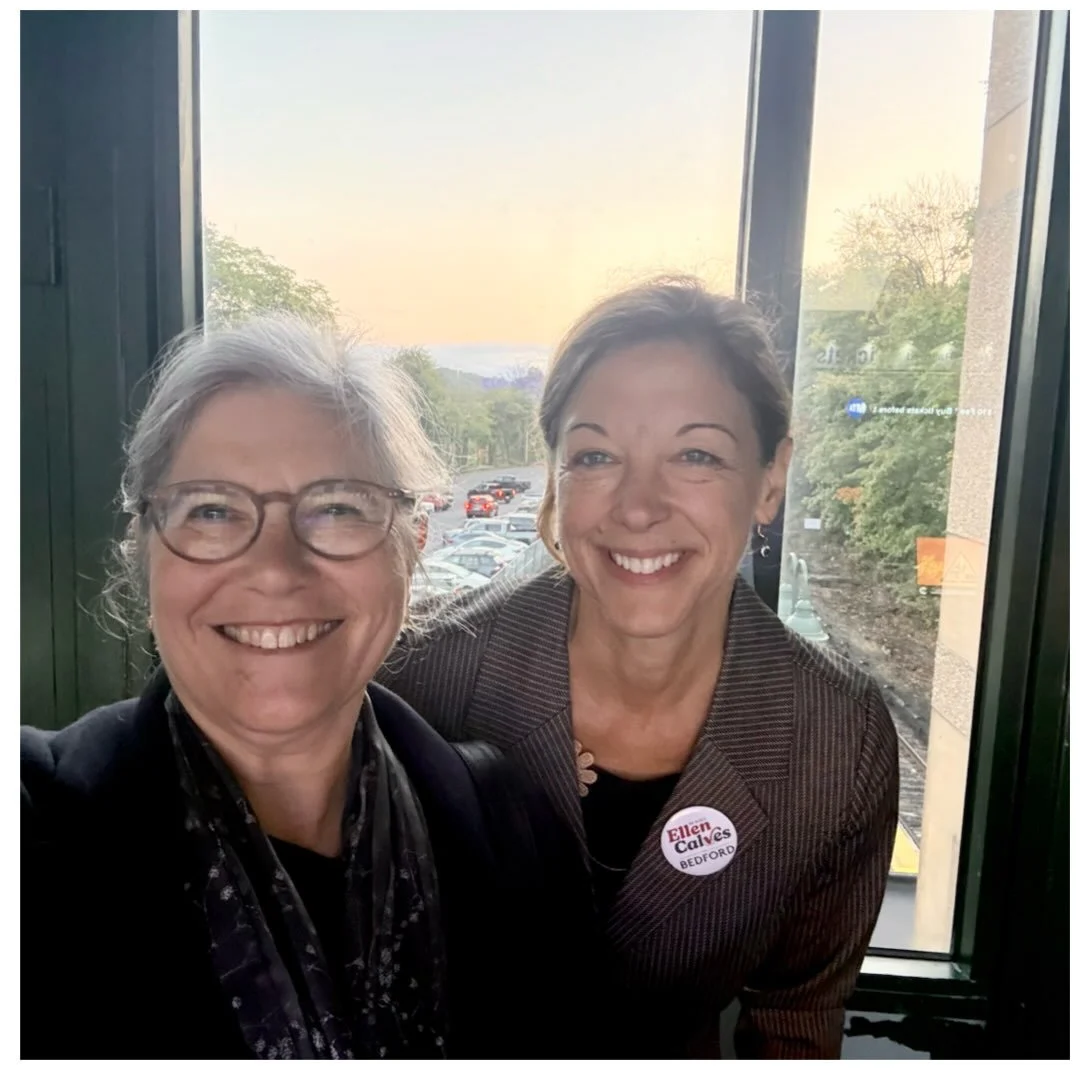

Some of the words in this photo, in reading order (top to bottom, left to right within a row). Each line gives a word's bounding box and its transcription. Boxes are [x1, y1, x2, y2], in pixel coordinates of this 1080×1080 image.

[666, 821, 712, 843] Ellen
[674, 826, 732, 854] Calves
[679, 845, 736, 870] BEDFORD
